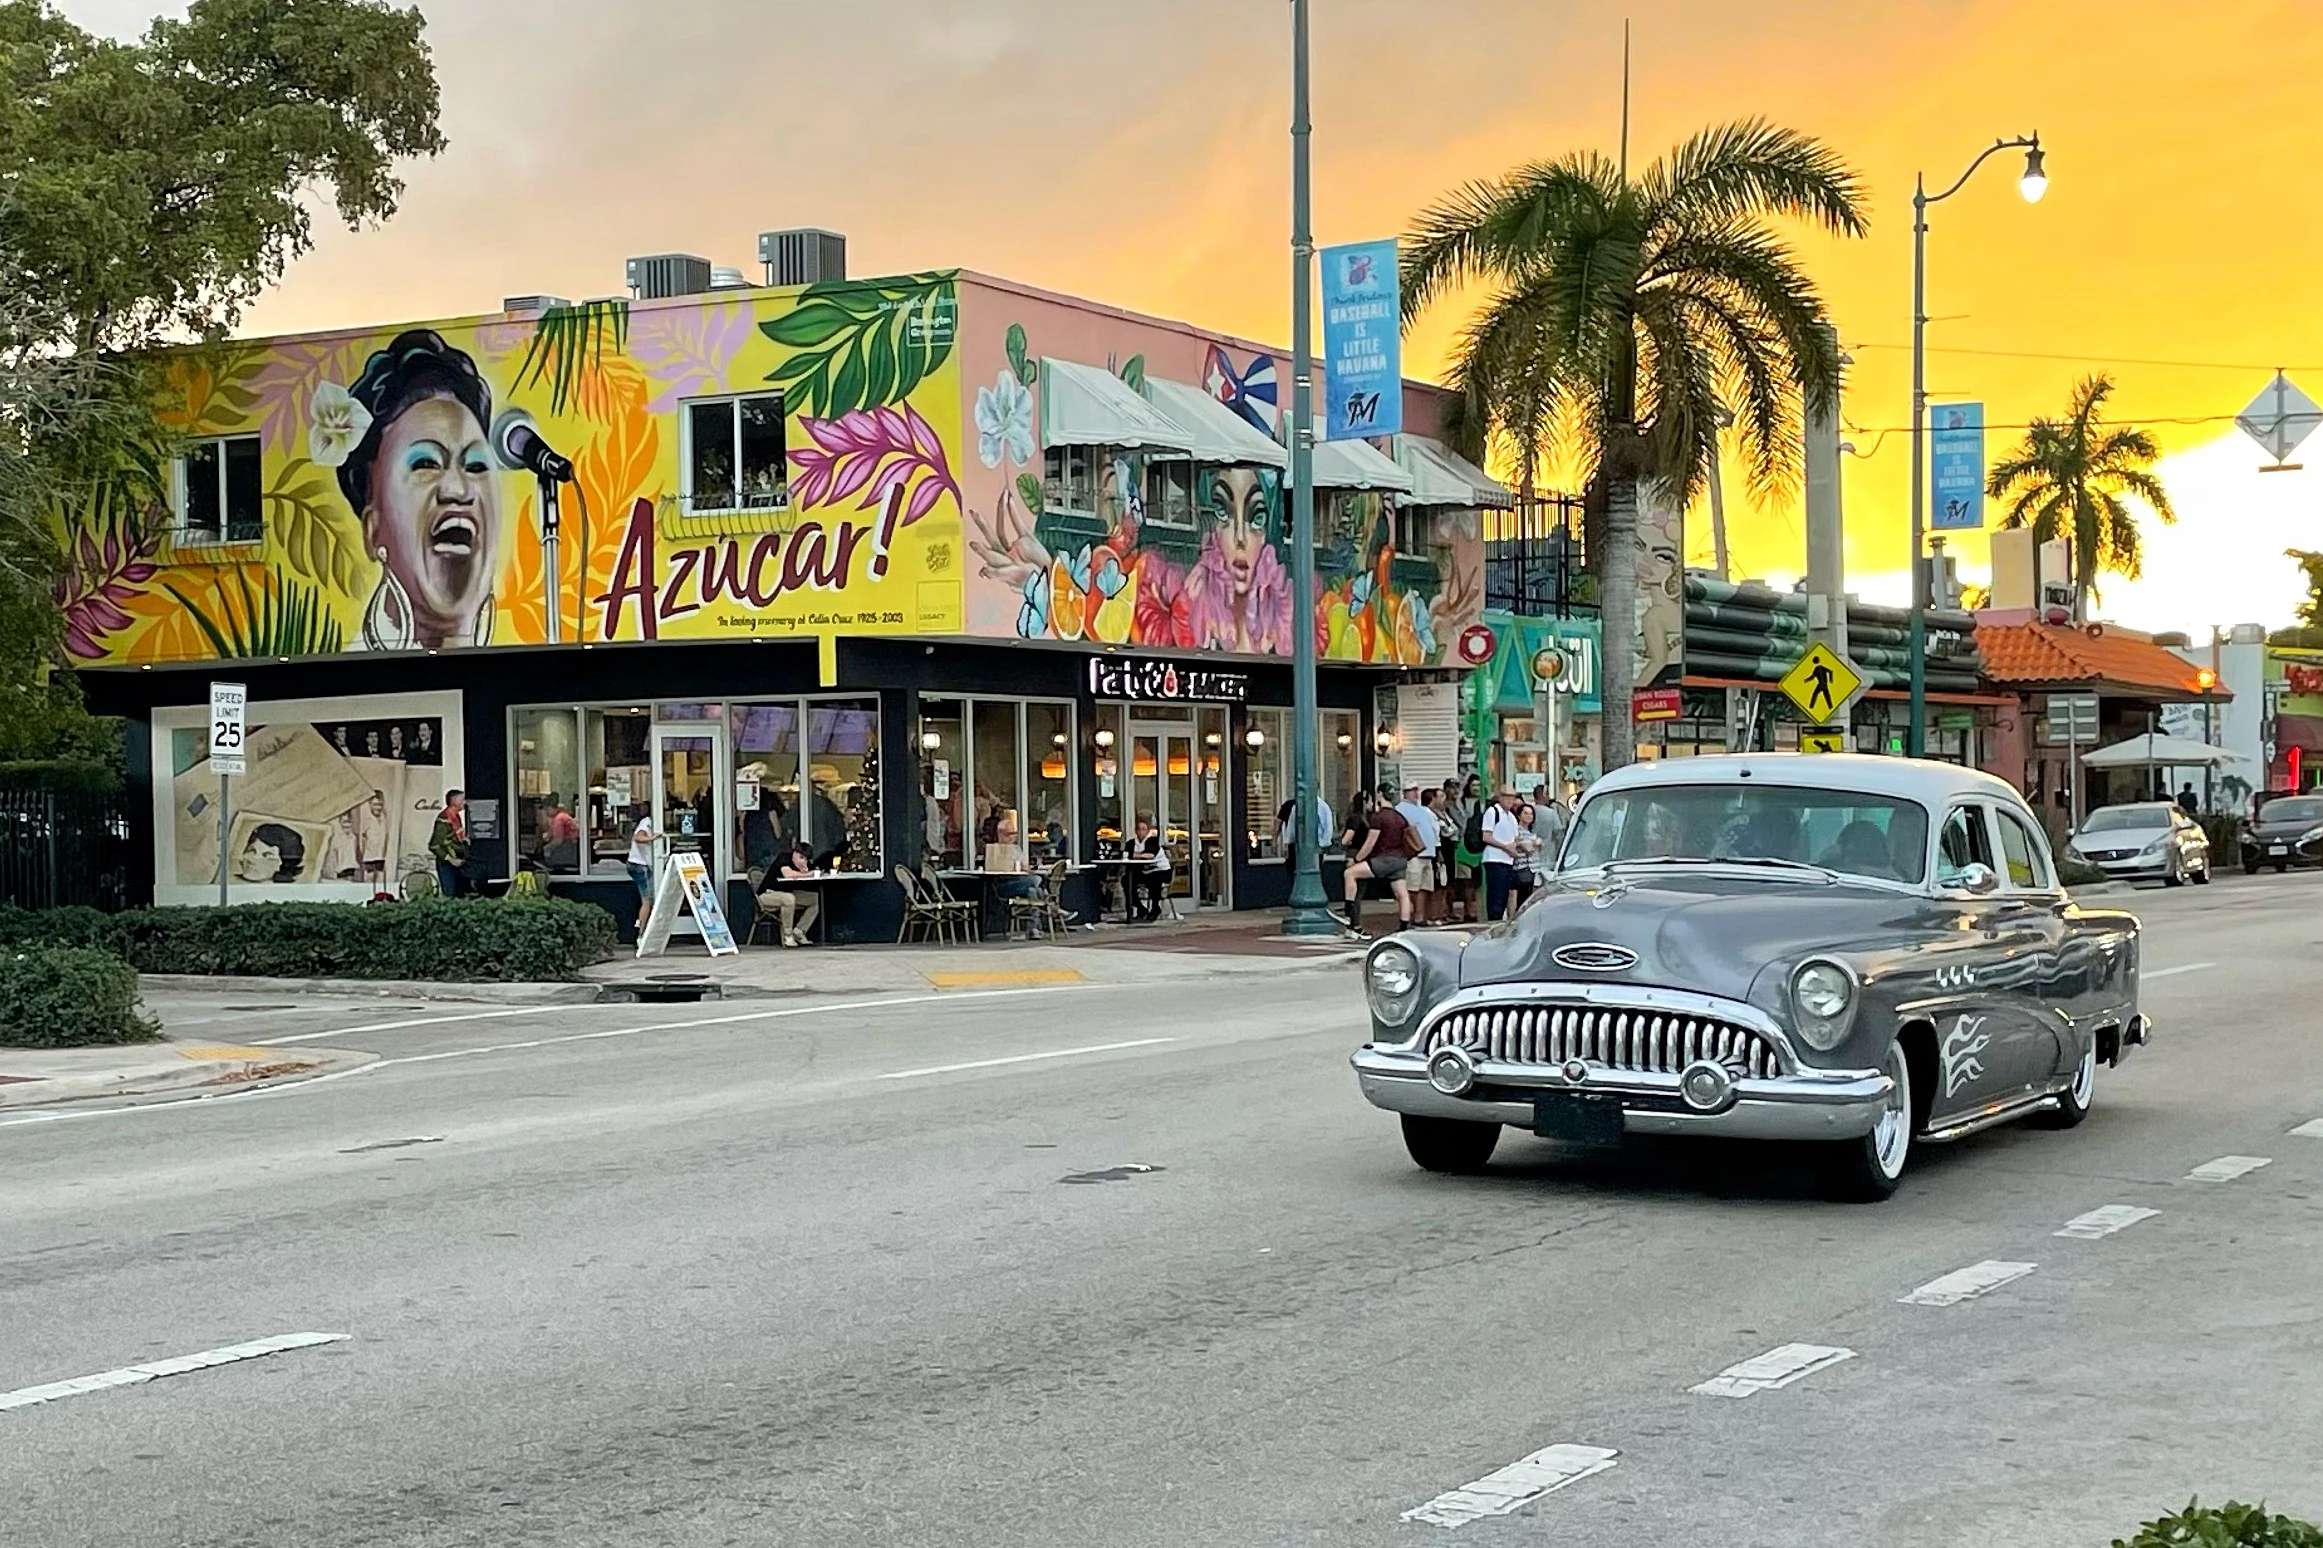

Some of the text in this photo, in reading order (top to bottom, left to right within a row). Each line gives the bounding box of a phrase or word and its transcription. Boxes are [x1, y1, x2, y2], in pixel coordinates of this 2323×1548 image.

[1330, 302, 1391, 324] BASEBALL
[1354, 322, 1367, 338] IS
[1343, 338, 1380, 357] LITTLE
[1337, 354, 1387, 376] HAVANA
[730, 616, 756, 631] loving
[758, 617, 796, 630] memory
[808, 613, 830, 625] Celia
[832, 613, 853, 624] Cruz
[214, 691, 243, 704] SPEED
[216, 706, 240, 718] LIMIT
[214, 721, 241, 748] 25
